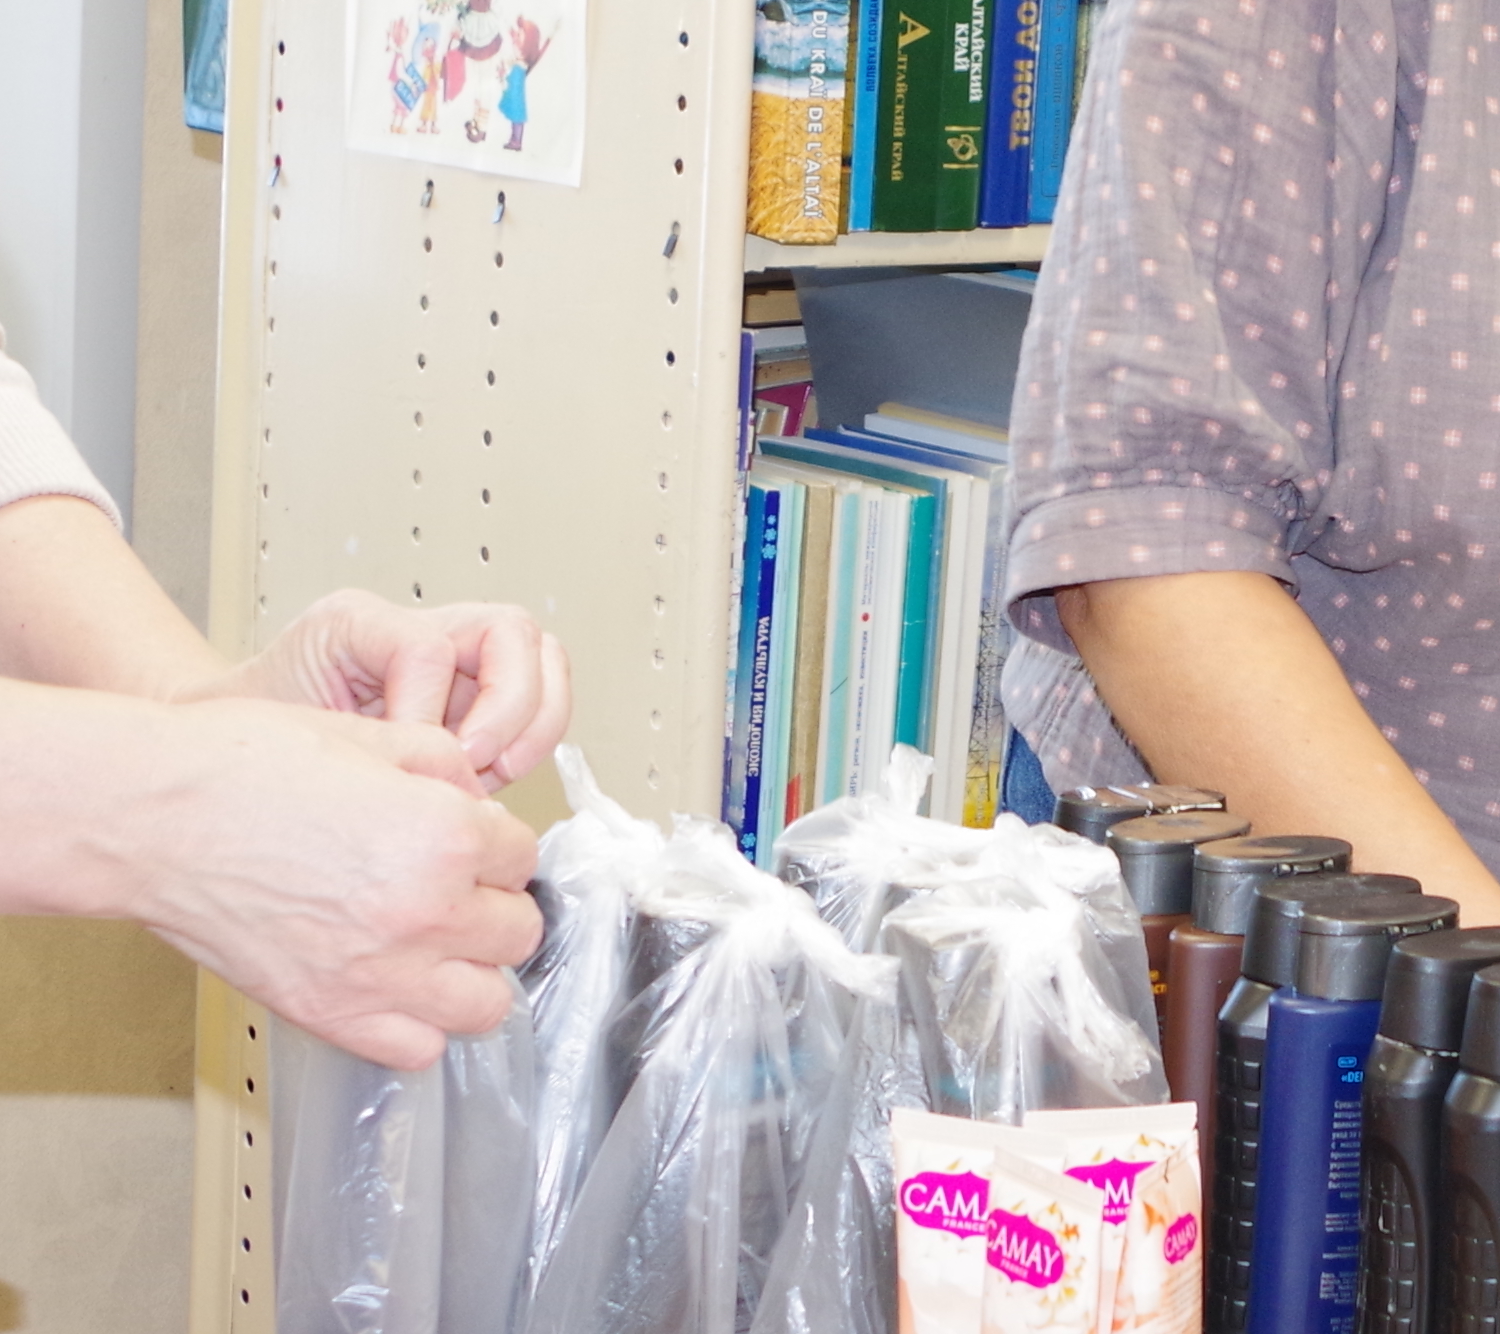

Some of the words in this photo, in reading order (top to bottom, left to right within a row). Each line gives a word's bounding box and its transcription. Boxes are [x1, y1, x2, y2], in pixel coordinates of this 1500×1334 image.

[809, 9, 831, 40] DU
[950, 21, 971, 73] КРАЙ
[807, 47, 831, 99] KRAÏ
[863, 44, 877, 92] ПОЛВЕКА
[887, 10, 930, 140] АЛТАЙСКИЙ
[805, 105, 826, 134] DE
[1007, 57, 1037, 152] ТВОИ
[887, 140, 907, 183] КРАЙ
[751, 614, 772, 690] КУЛЬТУРА
[751, 690, 765, 702] И
[743, 703, 765, 778] ЭКОЛОГИЯ
[1164, 1218, 1198, 1260] CAMAY
